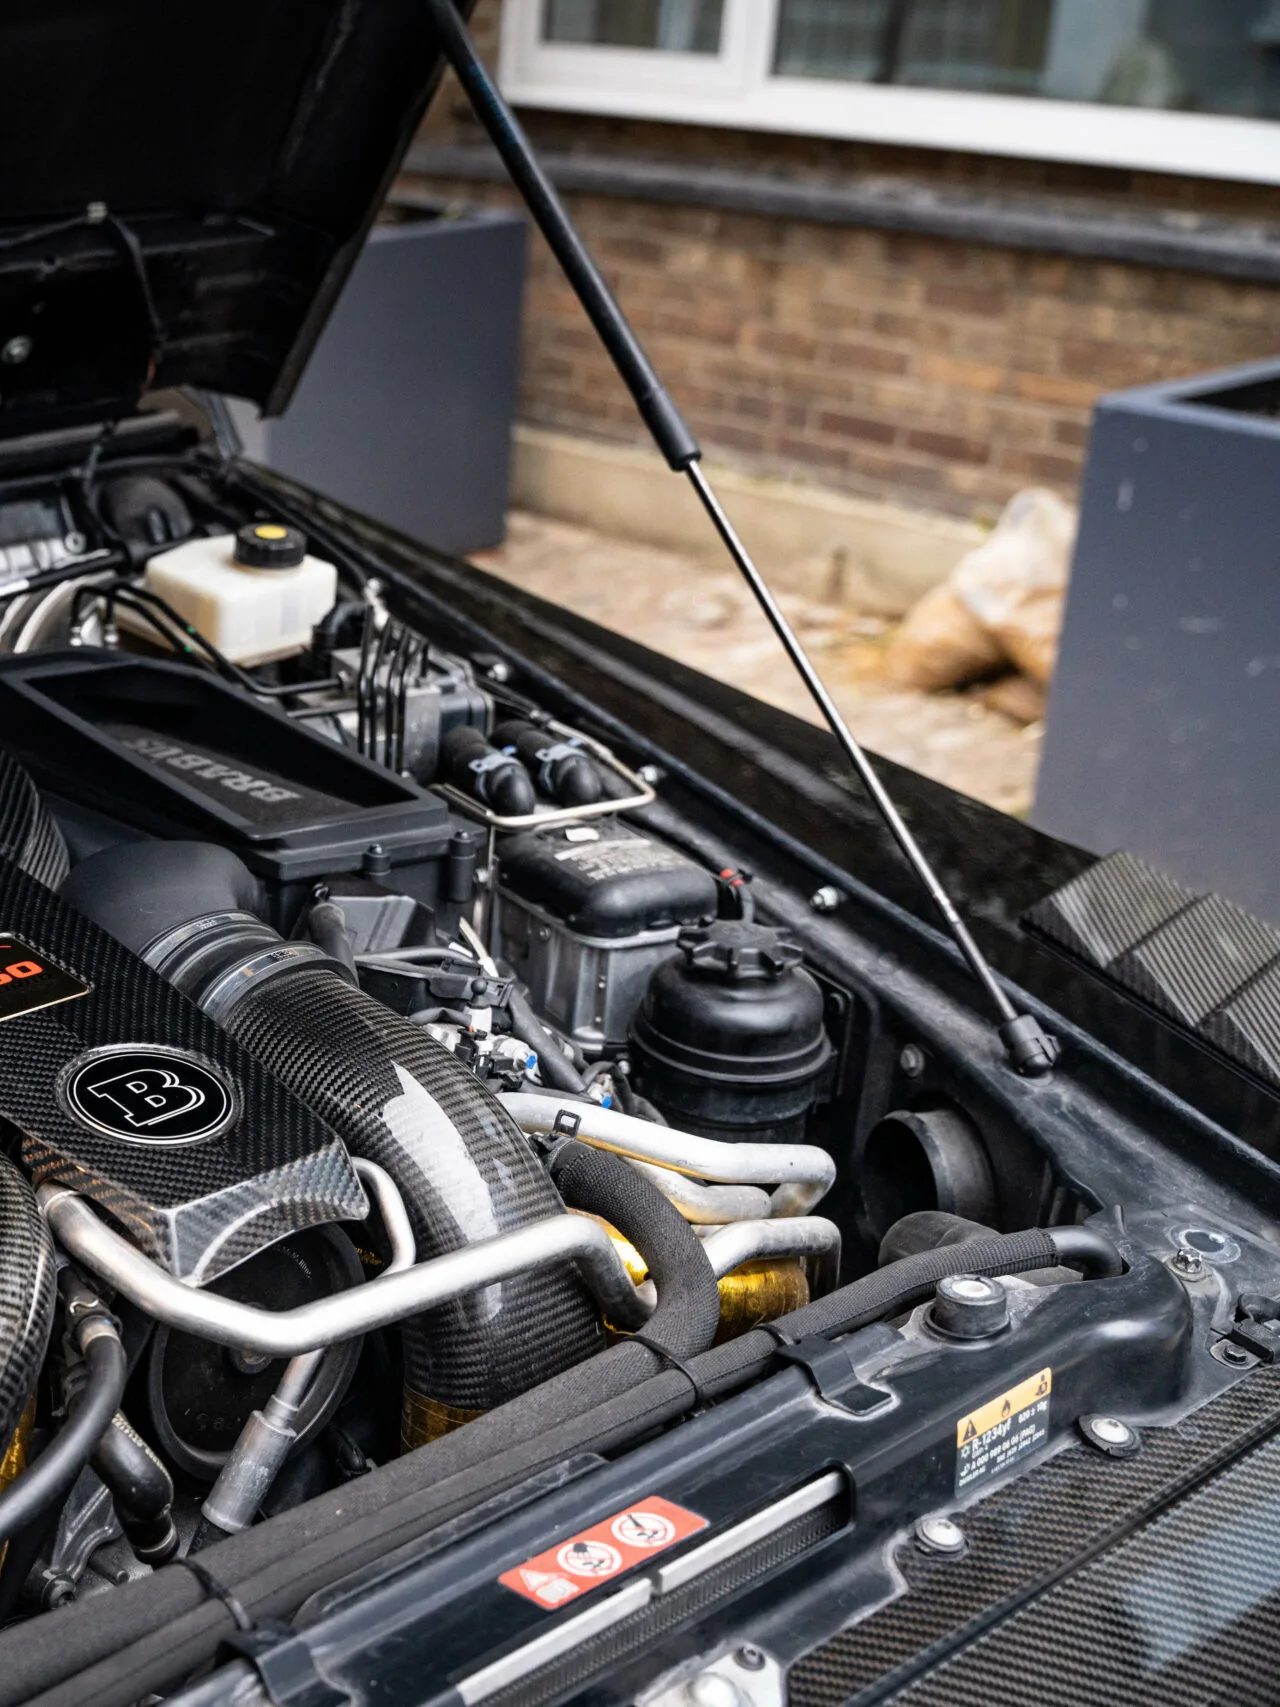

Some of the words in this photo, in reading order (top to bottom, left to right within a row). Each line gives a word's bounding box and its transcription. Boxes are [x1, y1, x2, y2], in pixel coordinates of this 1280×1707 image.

[122, 738, 304, 802] BRABUS
[87, 1068, 205, 1127] B
[972, 1417, 1012, 1452] R-1234yf
